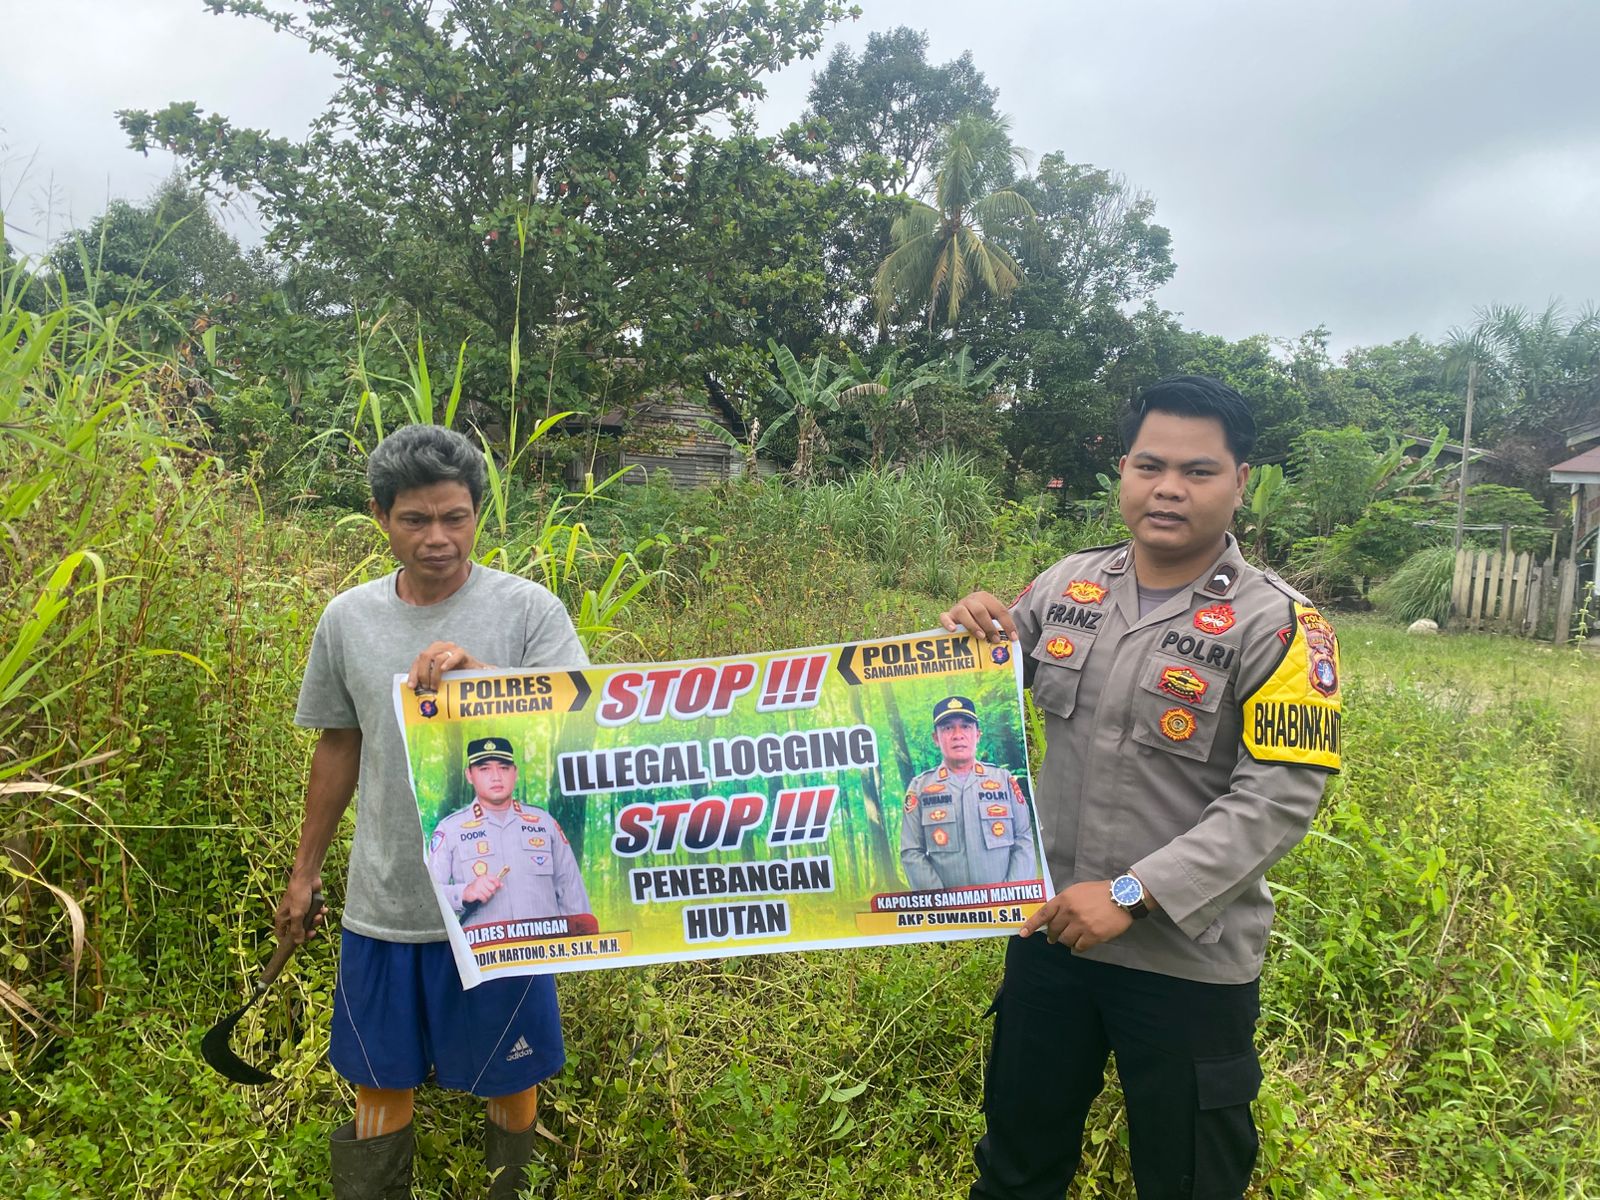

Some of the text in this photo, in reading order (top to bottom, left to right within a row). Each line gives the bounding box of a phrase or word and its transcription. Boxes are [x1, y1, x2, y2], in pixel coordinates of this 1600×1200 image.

[1046, 602, 1102, 630] FRANZ
[862, 636, 974, 667] POLSEK
[1161, 630, 1235, 670] POLRI
[863, 656, 975, 680] SANAMAN MANTIKEI
[459, 675, 553, 701] POLRES
[600, 654, 829, 722] STOP !!!
[459, 697, 553, 717] KATINGAN
[561, 727, 875, 792] ILLEGAL LOGGING
[978, 791, 1008, 801] POLRI
[521, 825, 546, 834] POLRI
[614, 788, 836, 854] STOP !!!
[460, 829, 487, 842] DODIK
[633, 859, 831, 902] PENEBANGAN
[877, 884, 1043, 910] KAPOLSEK SANAMAN MANTIKEI
[686, 902, 786, 940] HUTAN
[898, 908, 1026, 926] AKP SUWARDI, S.H.
[465, 919, 568, 945] OLRES KATINGAN
[499, 946, 549, 963] HARTONO,
[599, 938, 621, 954] M.H.
[506, 1047, 533, 1062] adidas
